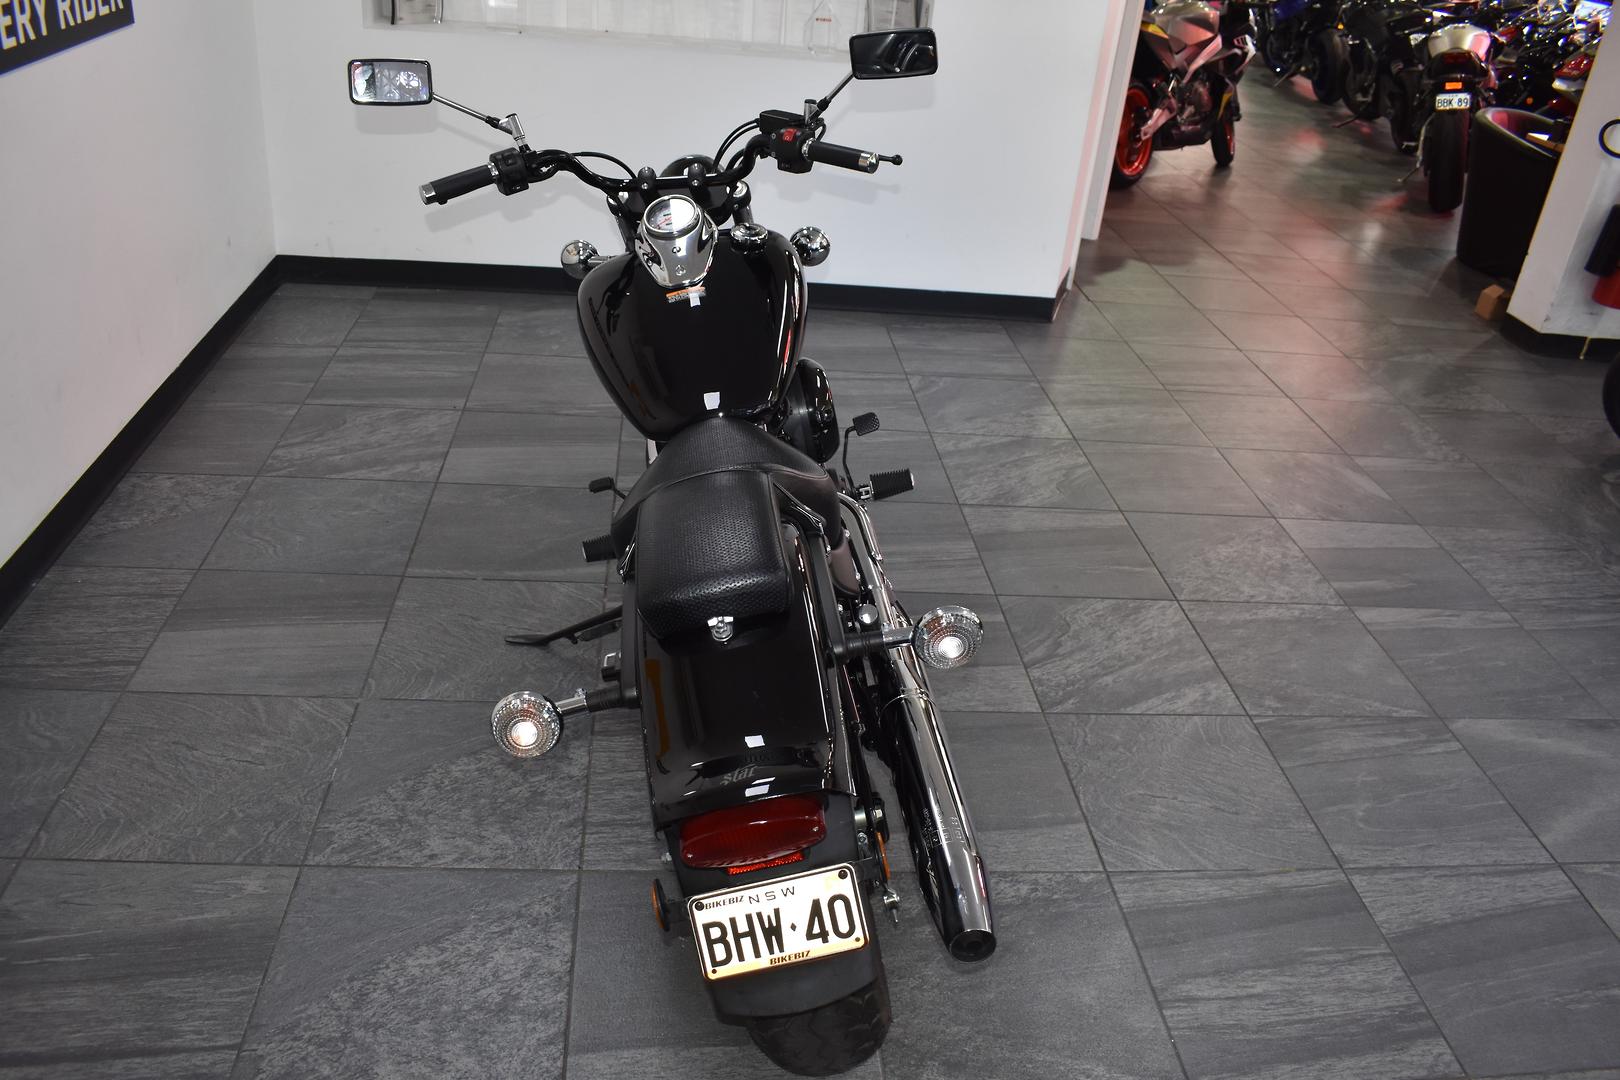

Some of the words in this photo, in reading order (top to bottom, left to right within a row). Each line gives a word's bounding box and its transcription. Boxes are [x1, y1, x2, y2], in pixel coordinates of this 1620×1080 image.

[57, 0, 124, 30] RID
[704, 895, 745, 910] BIKEBIZ
[748, 886, 796, 905] NSW
[702, 907, 786, 969] BHW
[804, 893, 857, 944] 40
[769, 950, 811, 966] BIKEBIZ
